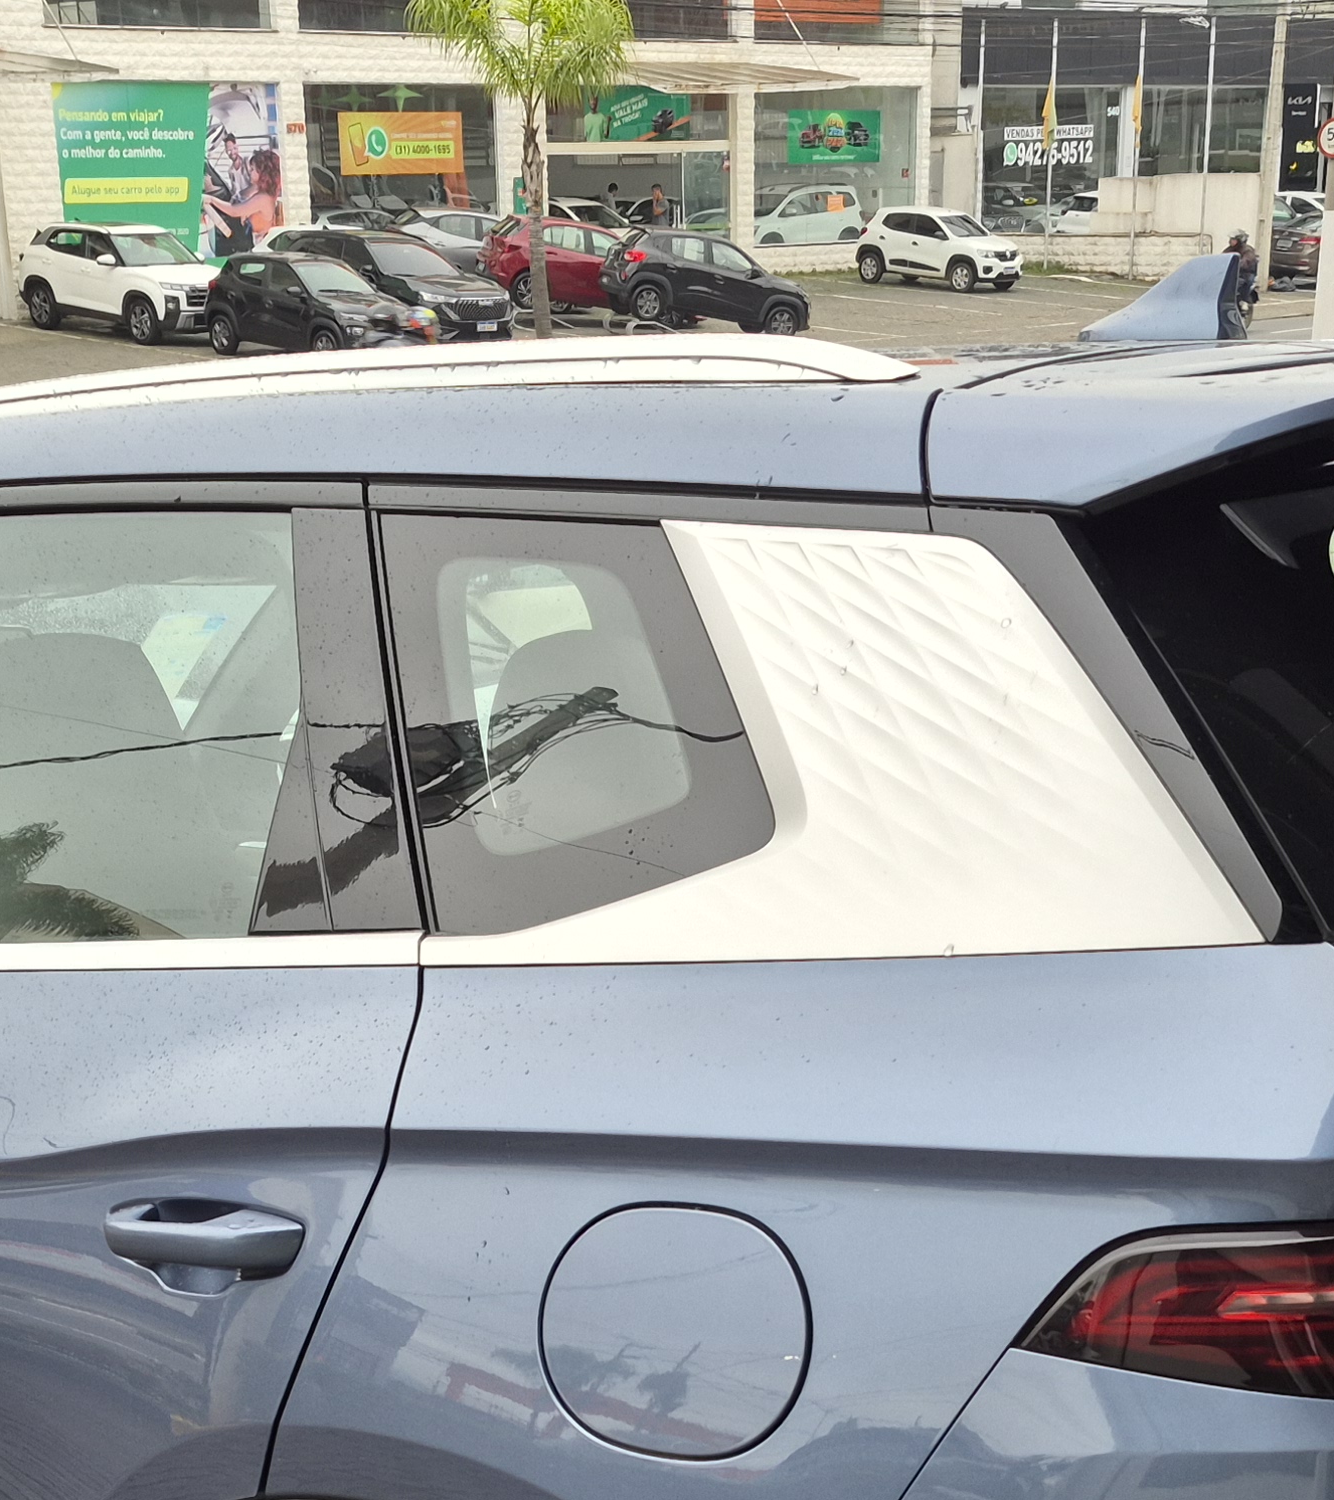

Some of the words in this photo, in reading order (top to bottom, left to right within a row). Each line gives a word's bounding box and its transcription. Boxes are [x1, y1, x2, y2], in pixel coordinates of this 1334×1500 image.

[58, 109, 109, 122] Pensando
[111, 112, 128, 122] em
[129, 109, 164, 124] viajar?
[60, 128, 83, 140] Com
[85, 131, 92, 140] a
[94, 129, 125, 142] gente,
[127, 127, 149, 140] você
[152, 128, 194, 140] descobre
[1006, 128, 1034, 138] VENDAS
[1055, 126, 1093, 137] WHATSAPP
[62, 149, 69, 158] o
[71, 146, 105, 158] melhor
[108, 146, 120, 158] do
[122, 146, 165, 158] caminho.
[71, 185, 101, 197] Alugue
[104, 187, 118, 195] seu
[121, 187, 142, 195] carro
[145, 185, 162, 196] pelo
[165, 187, 180, 196] app
